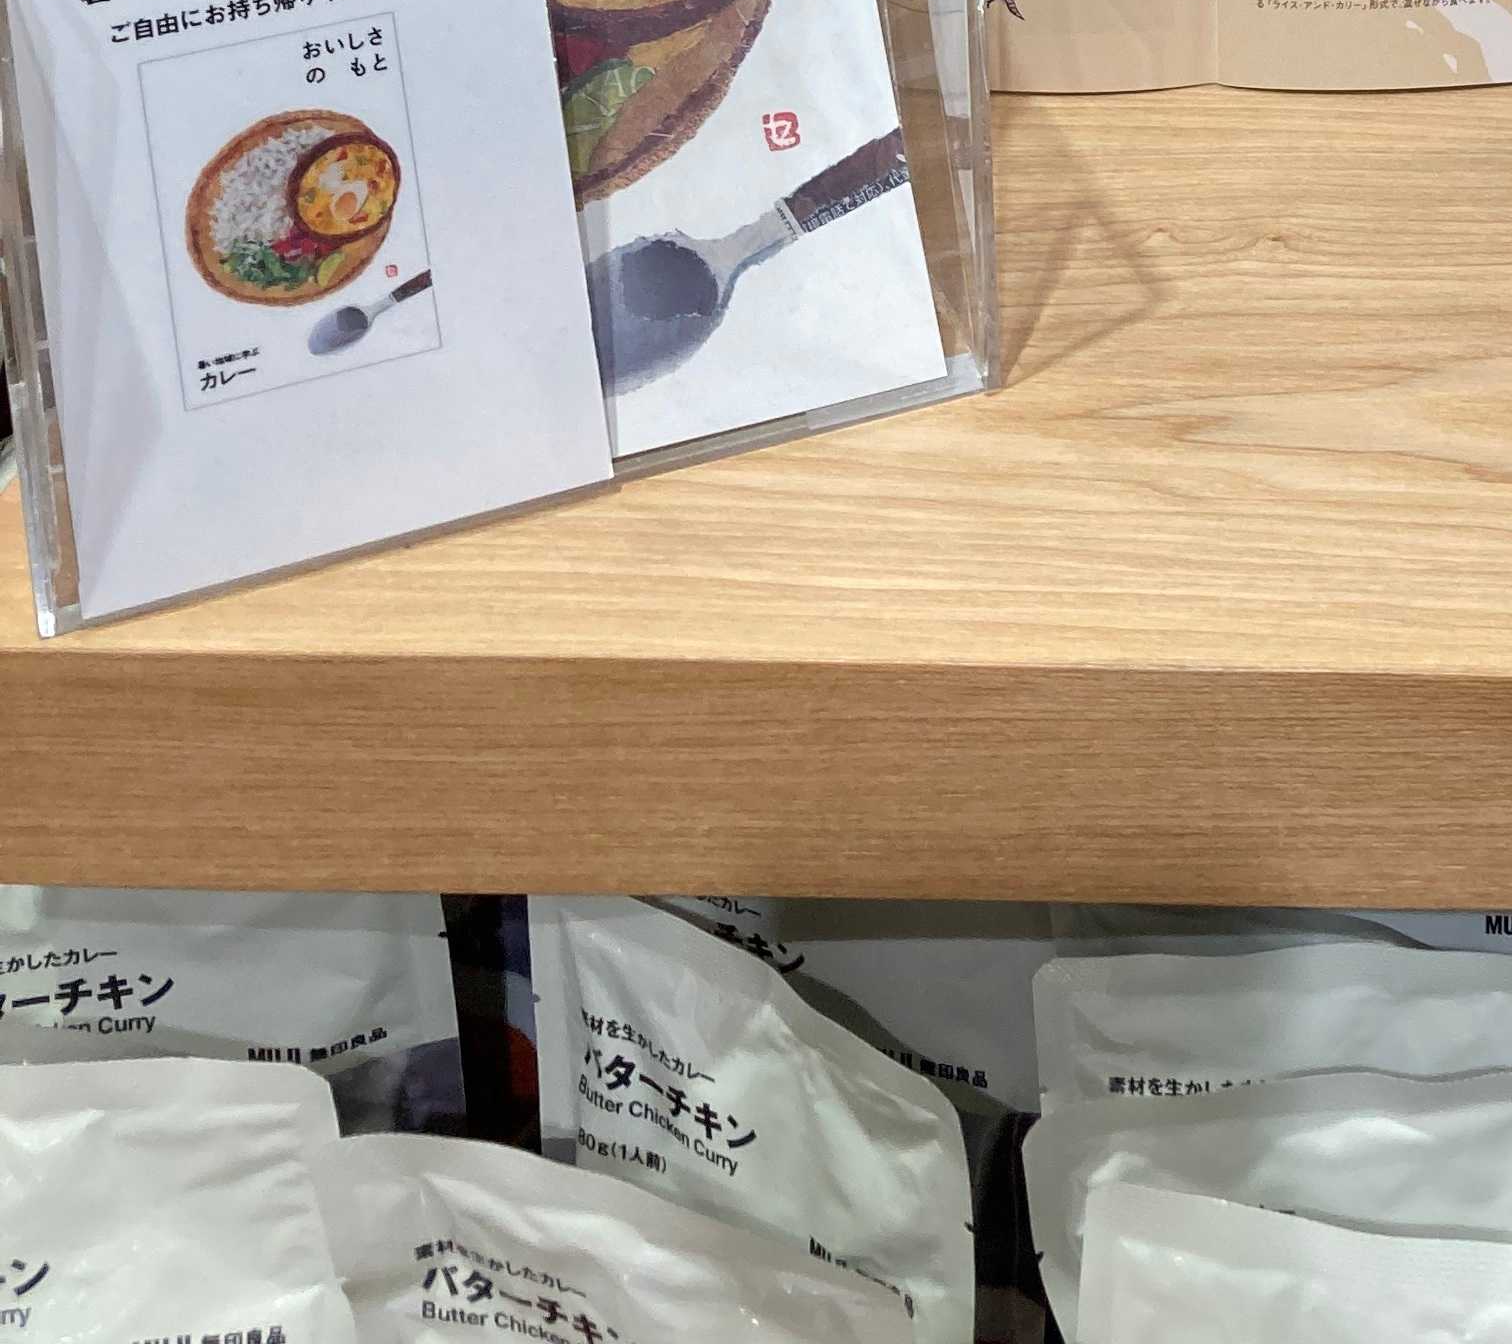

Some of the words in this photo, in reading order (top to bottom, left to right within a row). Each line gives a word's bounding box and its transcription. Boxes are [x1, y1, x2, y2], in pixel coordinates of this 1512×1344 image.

[302, 25, 385, 61] おいしさ
[350, 53, 389, 77] もと
[200, 368, 257, 392] カレー
[0, 973, 175, 1020] ーチキン
[98, 1015, 156, 1034] Curry
[583, 1041, 758, 1149] バターチキン
[578, 1073, 624, 1115] Butter
[629, 1100, 690, 1150] Chicken
[694, 1139, 739, 1177] Curry
[421, 1299, 489, 1327] Butter
